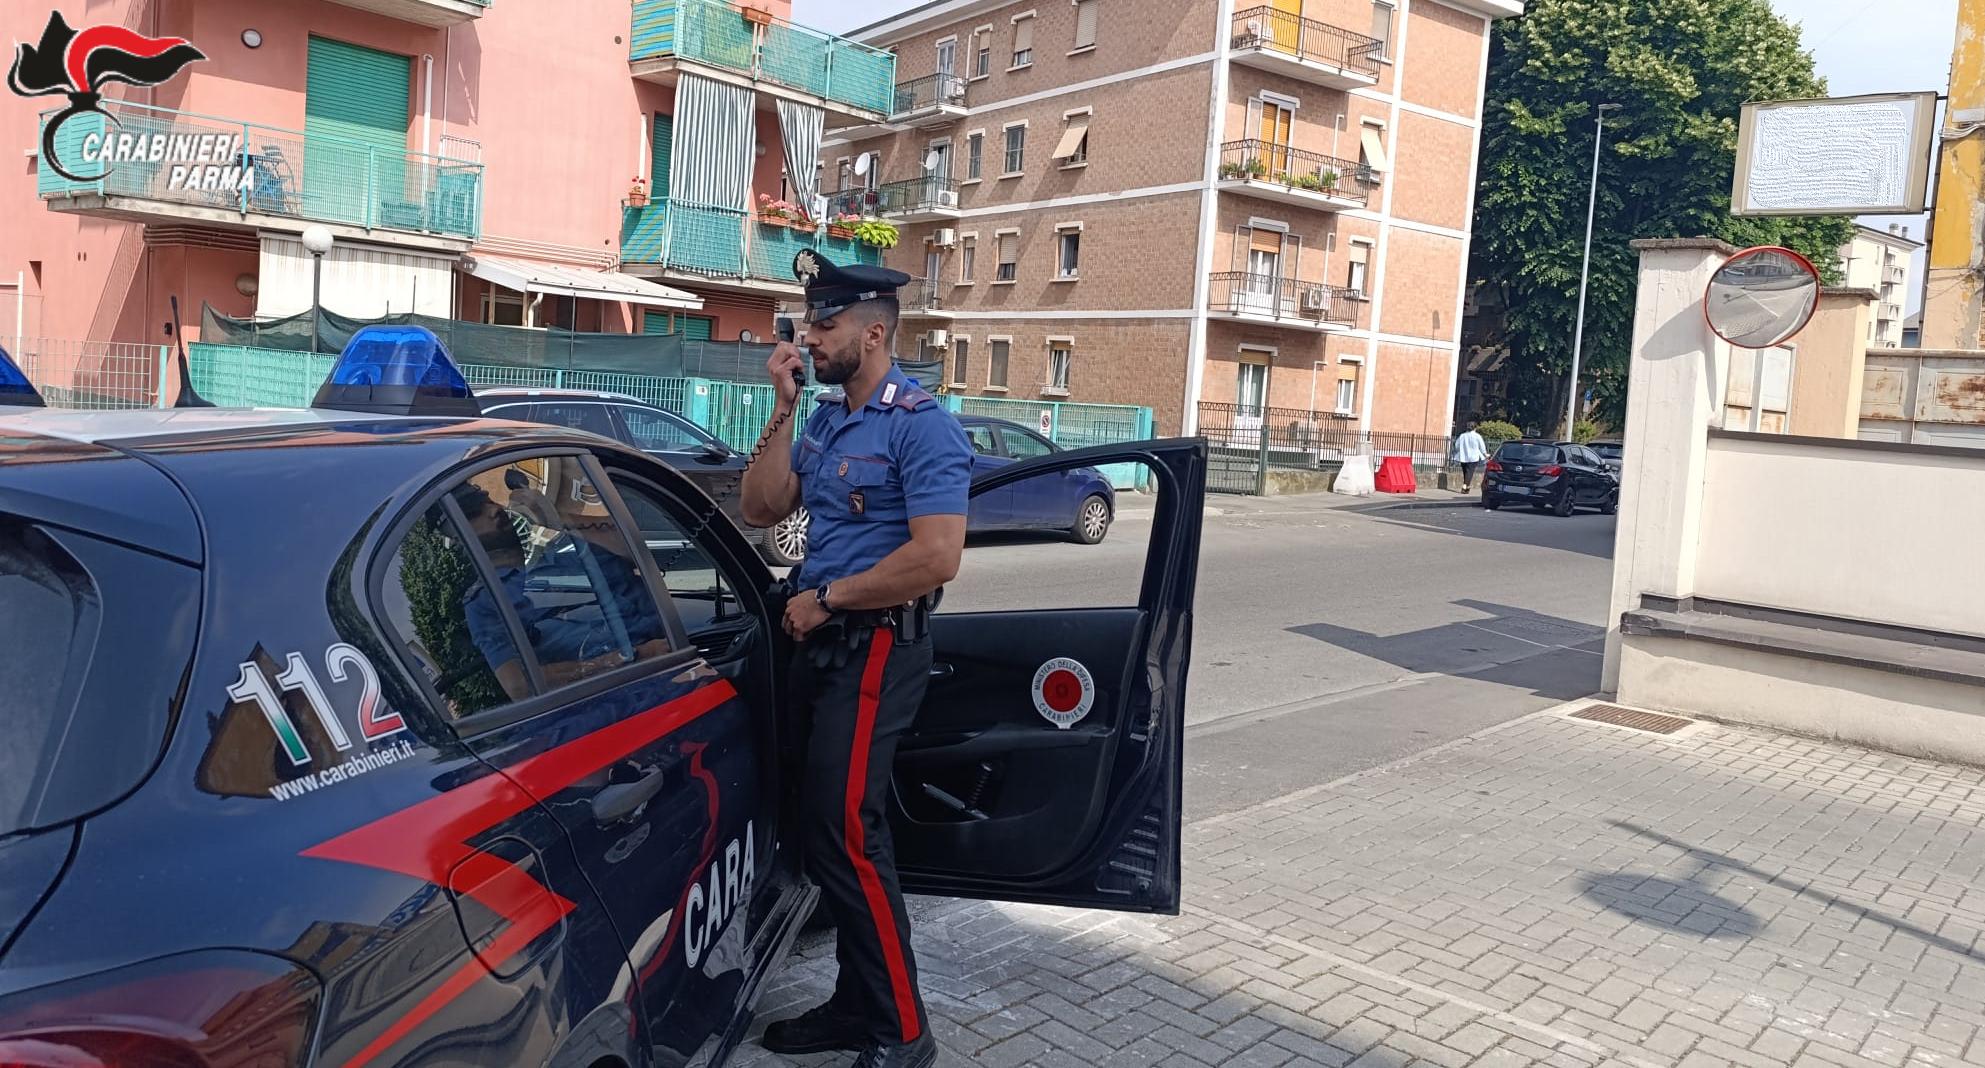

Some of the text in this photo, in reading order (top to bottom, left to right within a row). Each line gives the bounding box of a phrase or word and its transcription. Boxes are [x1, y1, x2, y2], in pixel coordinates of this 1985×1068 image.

[1057, 660, 1078, 671] DELLA
[225, 642, 408, 766] 112
[1038, 702, 1087, 721] CARABINIERI
[268, 738, 416, 802] www.carabinieri.it
[684, 819, 755, 969] CARA
